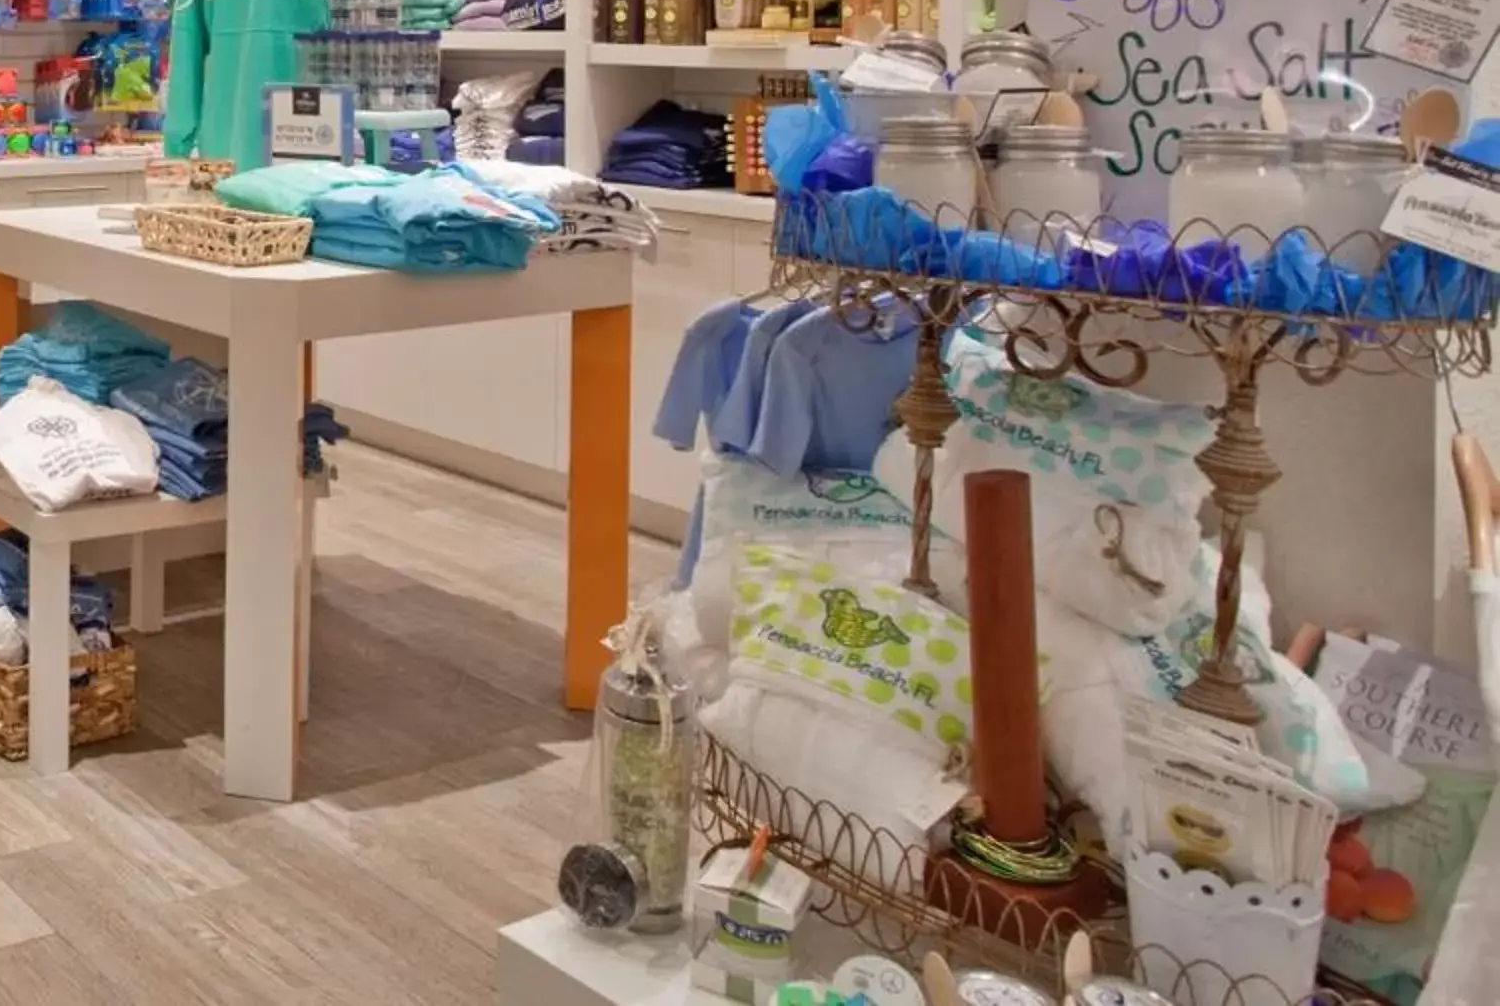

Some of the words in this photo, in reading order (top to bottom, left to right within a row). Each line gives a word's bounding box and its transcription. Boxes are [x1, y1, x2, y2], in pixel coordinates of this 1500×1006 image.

[1085, 31, 1214, 107] Sea
[1227, 18, 1376, 101] Salt
[1081, 453, 1106, 476] FL
[913, 683, 937, 711] FL
